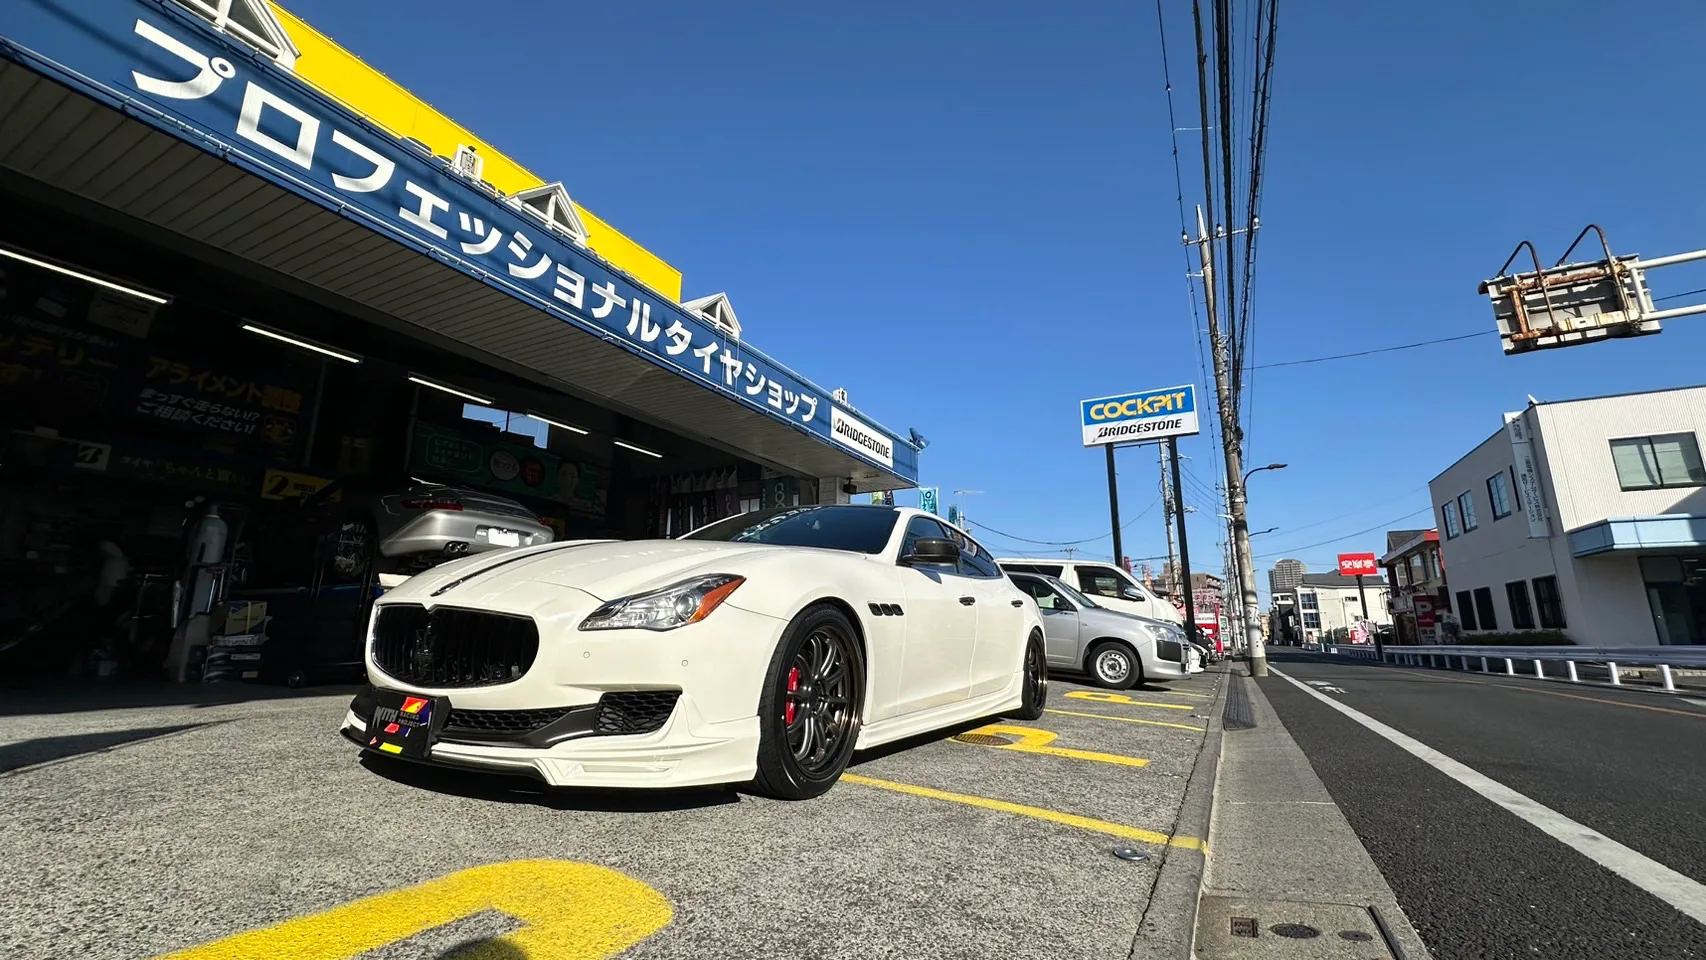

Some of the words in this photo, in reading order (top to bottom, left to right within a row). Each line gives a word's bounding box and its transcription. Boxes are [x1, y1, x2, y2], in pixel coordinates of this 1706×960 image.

[131, 18, 818, 422] プロフェッショナルタイヤショップ
[1090, 392, 1185, 420] COCKPIT
[836, 418, 890, 458] BRIDGESTONE
[1098, 419, 1182, 437] BRIDGESTONE
